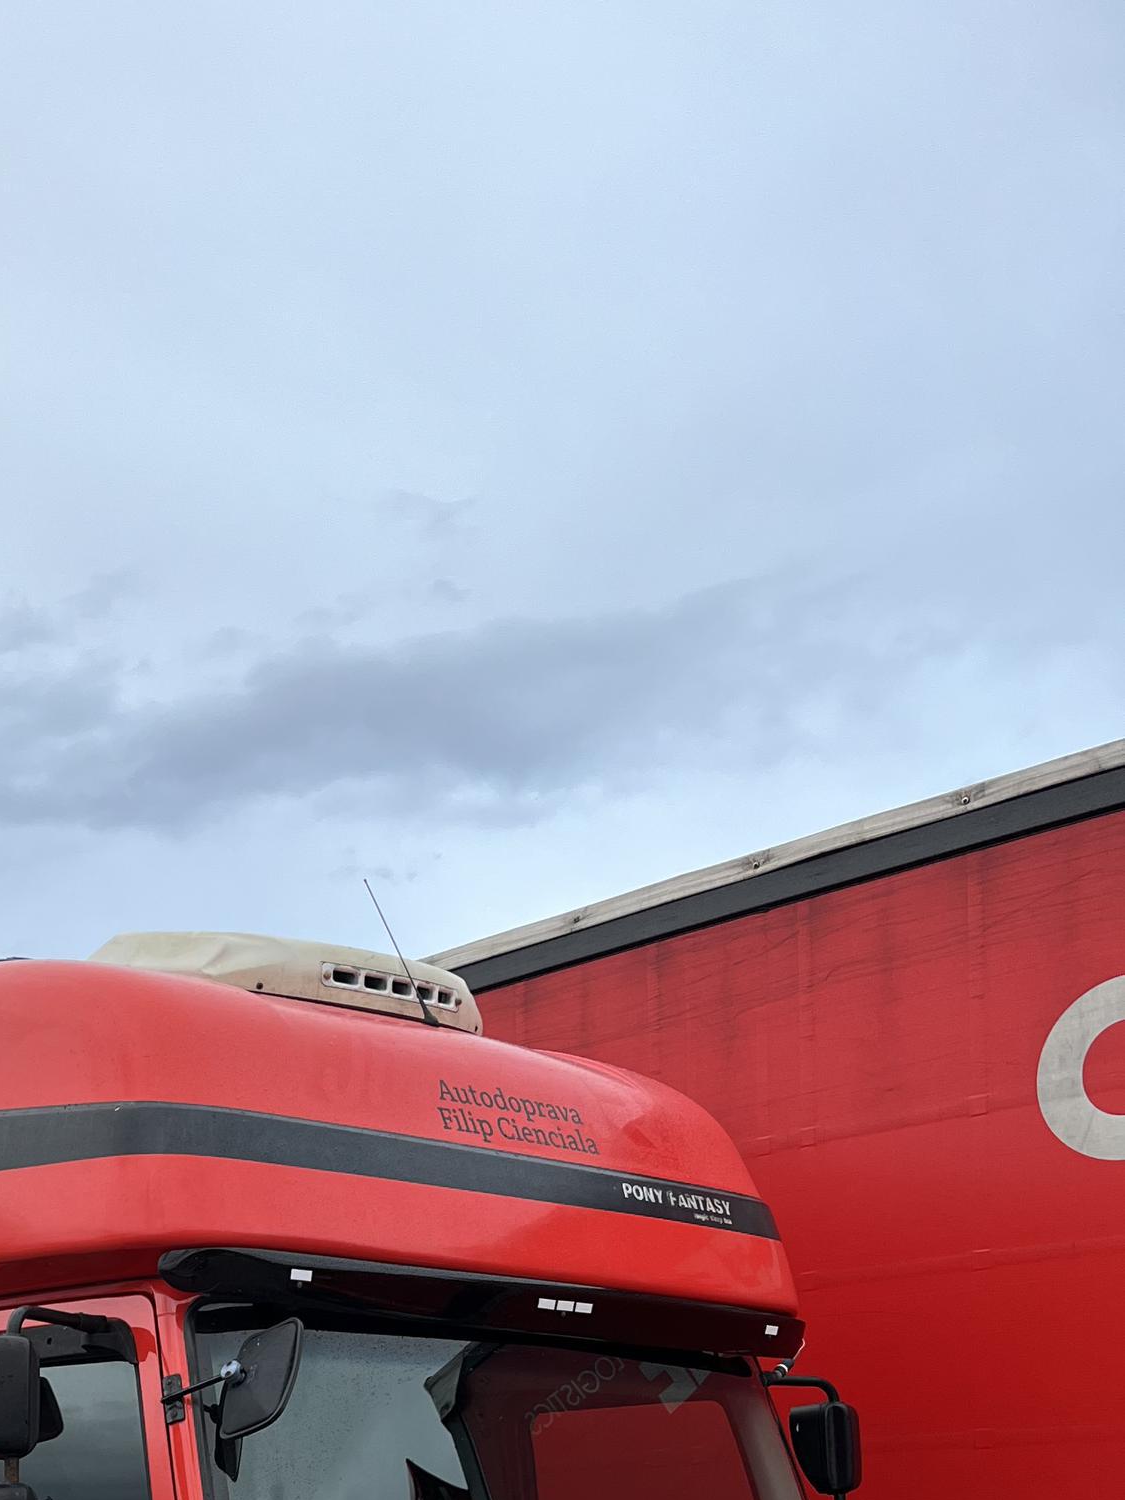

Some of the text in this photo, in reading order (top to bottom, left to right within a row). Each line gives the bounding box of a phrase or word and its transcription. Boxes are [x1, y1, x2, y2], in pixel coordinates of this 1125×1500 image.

[438, 1079, 584, 1126] Autodoprava
[437, 1106, 600, 1155] Filip Cienciala
[621, 1182, 731, 1216] PONY FANTASY
